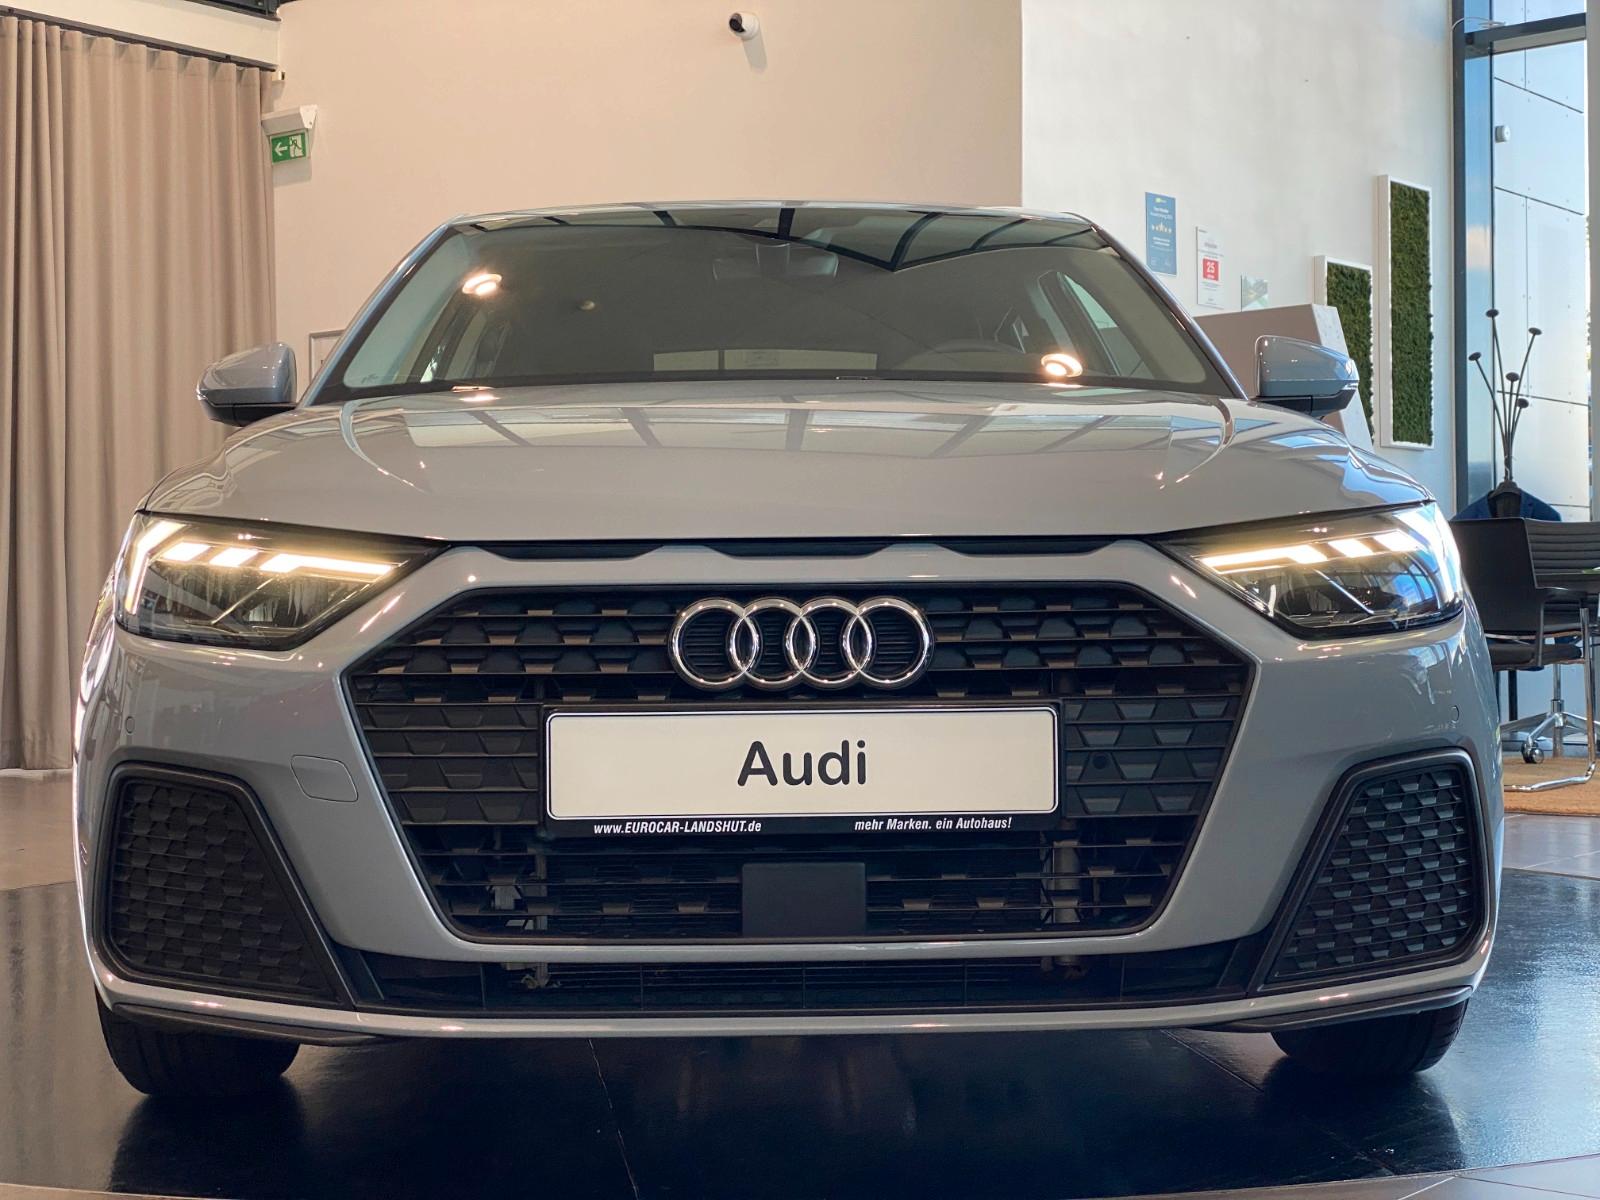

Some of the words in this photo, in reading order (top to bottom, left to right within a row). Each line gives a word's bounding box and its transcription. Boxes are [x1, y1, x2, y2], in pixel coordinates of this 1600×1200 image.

[737, 739, 867, 787] Audi
[593, 820, 762, 834] www.EUROCAR-LANDSHUT.de
[854, 818, 885, 831] mehr
[886, 818, 932, 831] Marken.
[935, 817, 953, 830] ein
[955, 816, 1012, 830] Autohaus!
